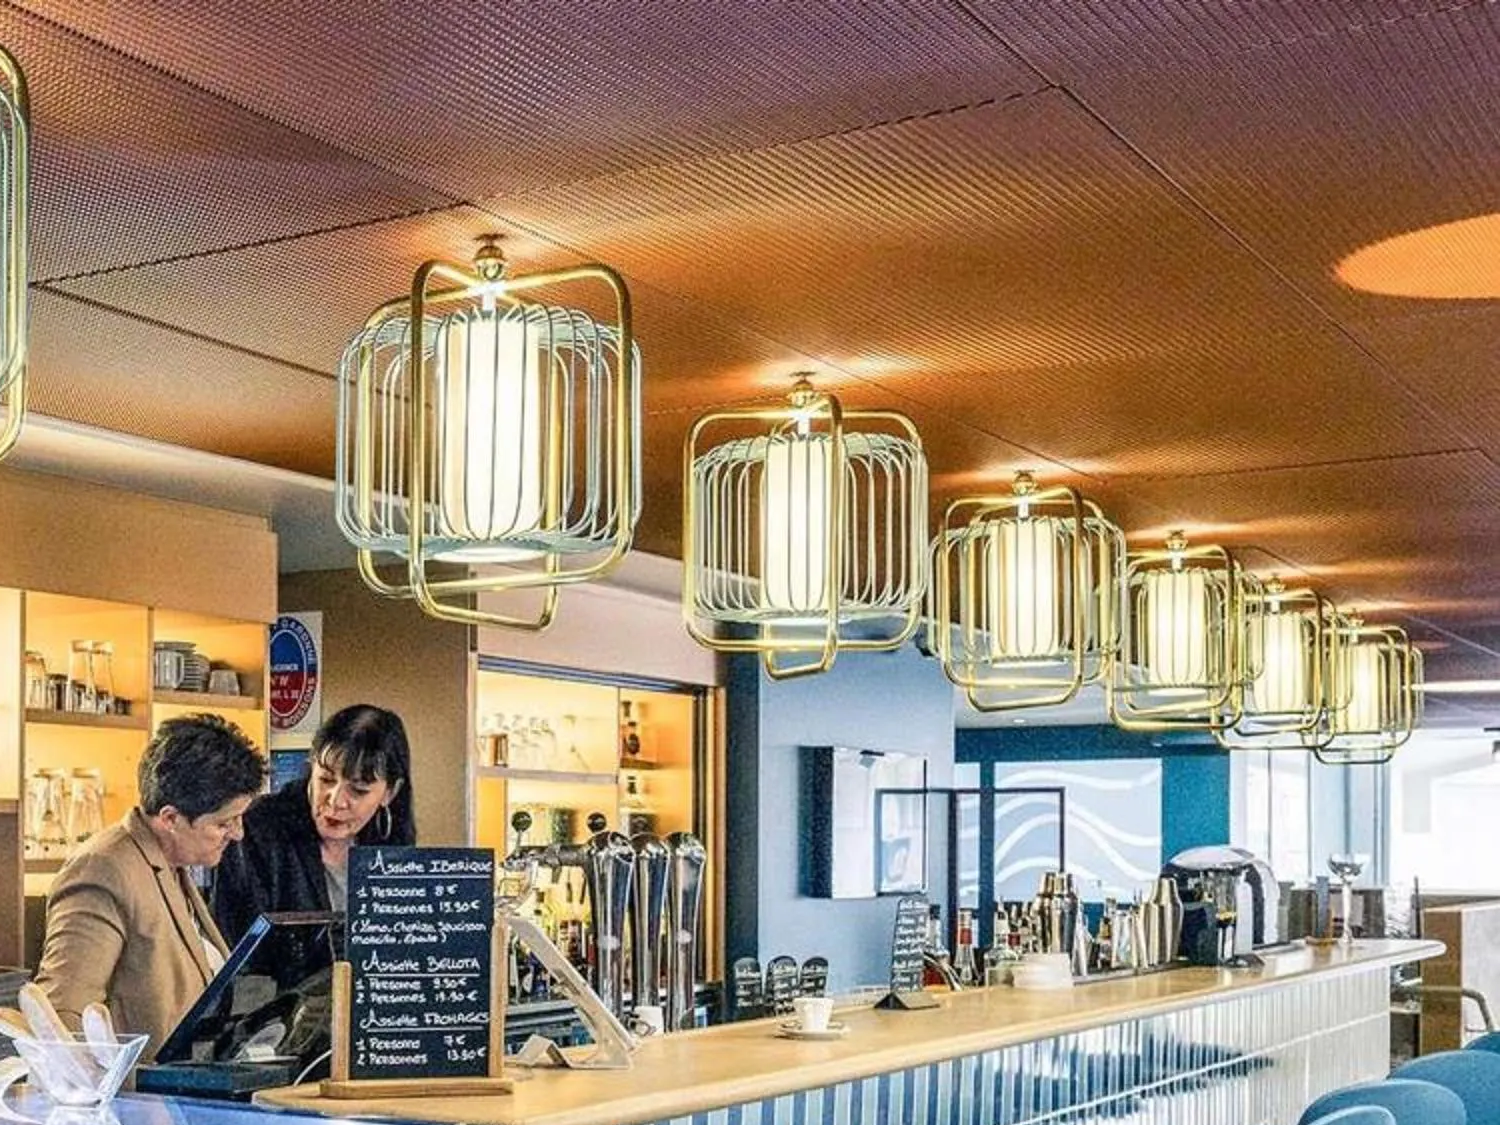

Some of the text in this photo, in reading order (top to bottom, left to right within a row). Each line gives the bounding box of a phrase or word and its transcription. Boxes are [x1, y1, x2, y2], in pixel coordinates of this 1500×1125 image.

[356, 885, 368, 898] 1
[358, 903, 367, 915] 2
[355, 978, 365, 991] 1
[355, 992, 365, 1004] 2
[355, 1038, 366, 1051] 1
[356, 1053, 366, 1067] 2
